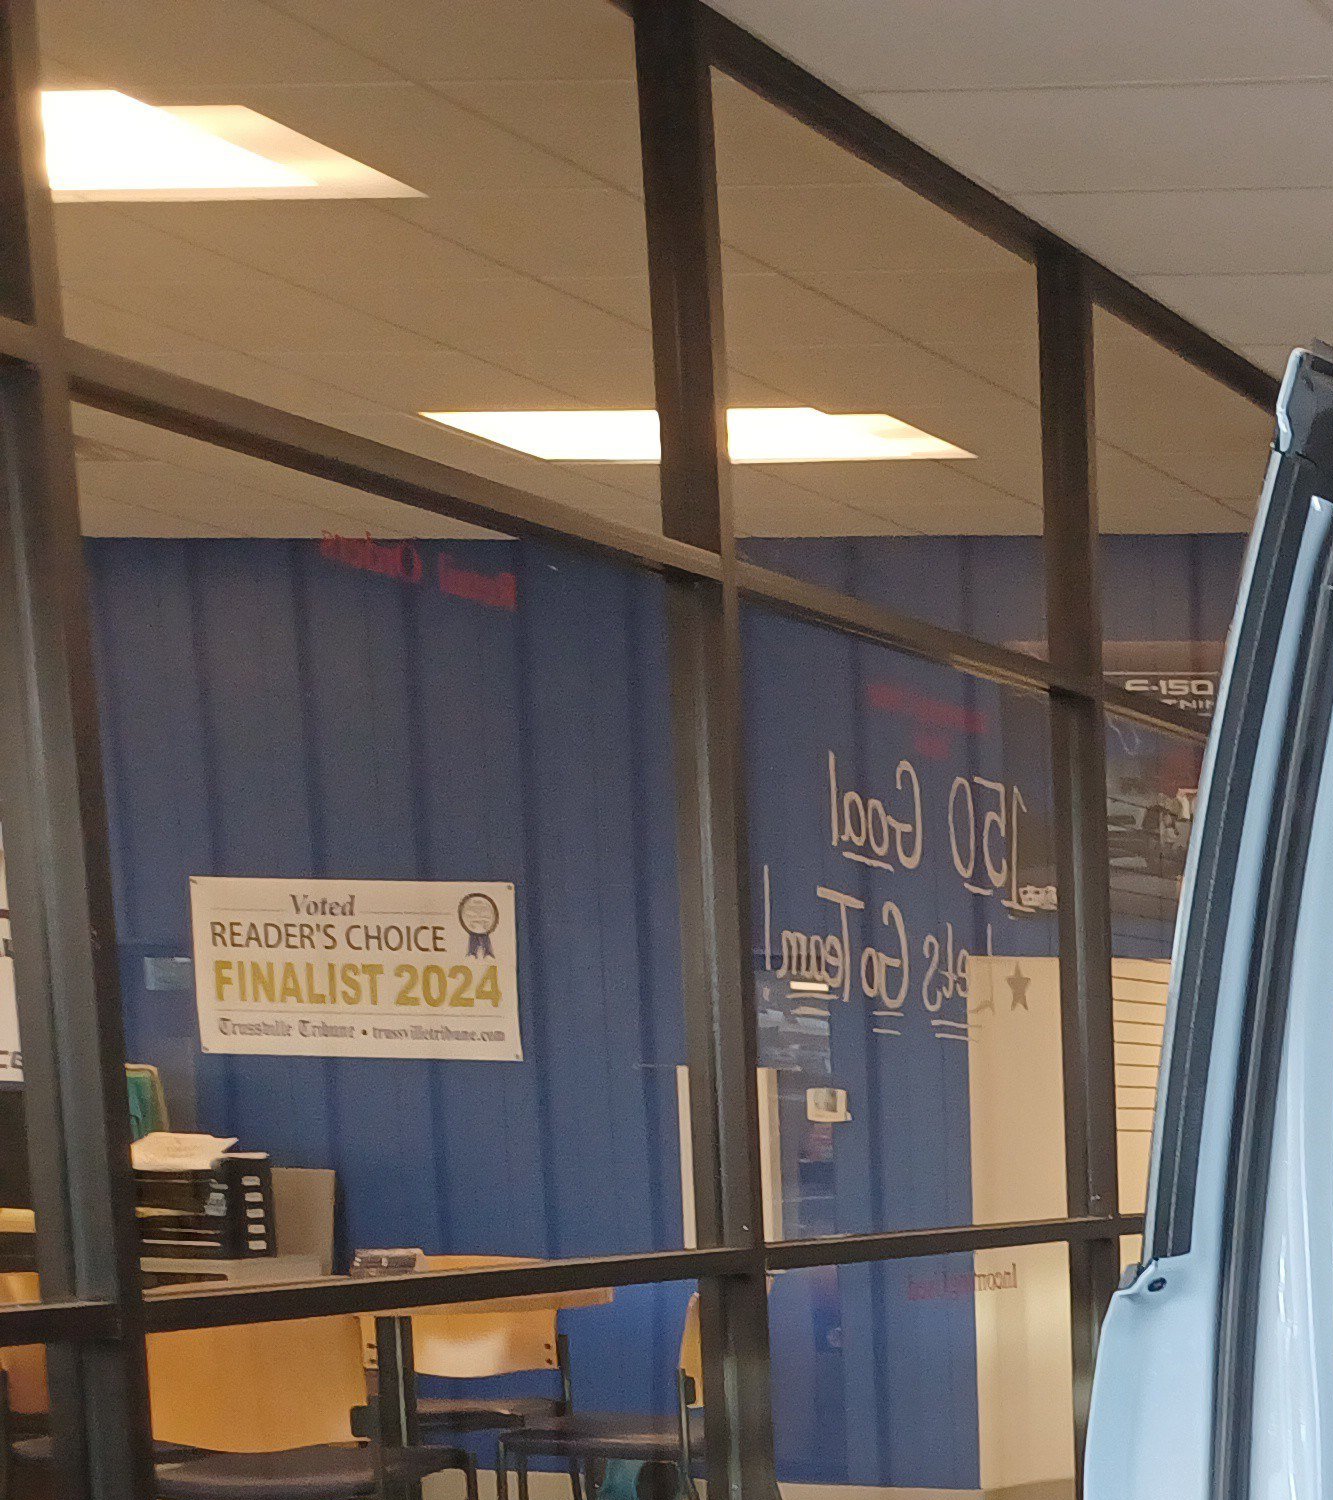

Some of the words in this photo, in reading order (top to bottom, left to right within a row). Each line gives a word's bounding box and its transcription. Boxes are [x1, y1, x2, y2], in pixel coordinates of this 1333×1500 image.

[289, 893, 356, 917] Voted
[209, 920, 338, 949] READER'S
[344, 924, 448, 952] CHOICE
[213, 960, 385, 1006] FINALIST
[393, 963, 503, 1008] 2024
[298, 1018, 356, 1039] Tribune
